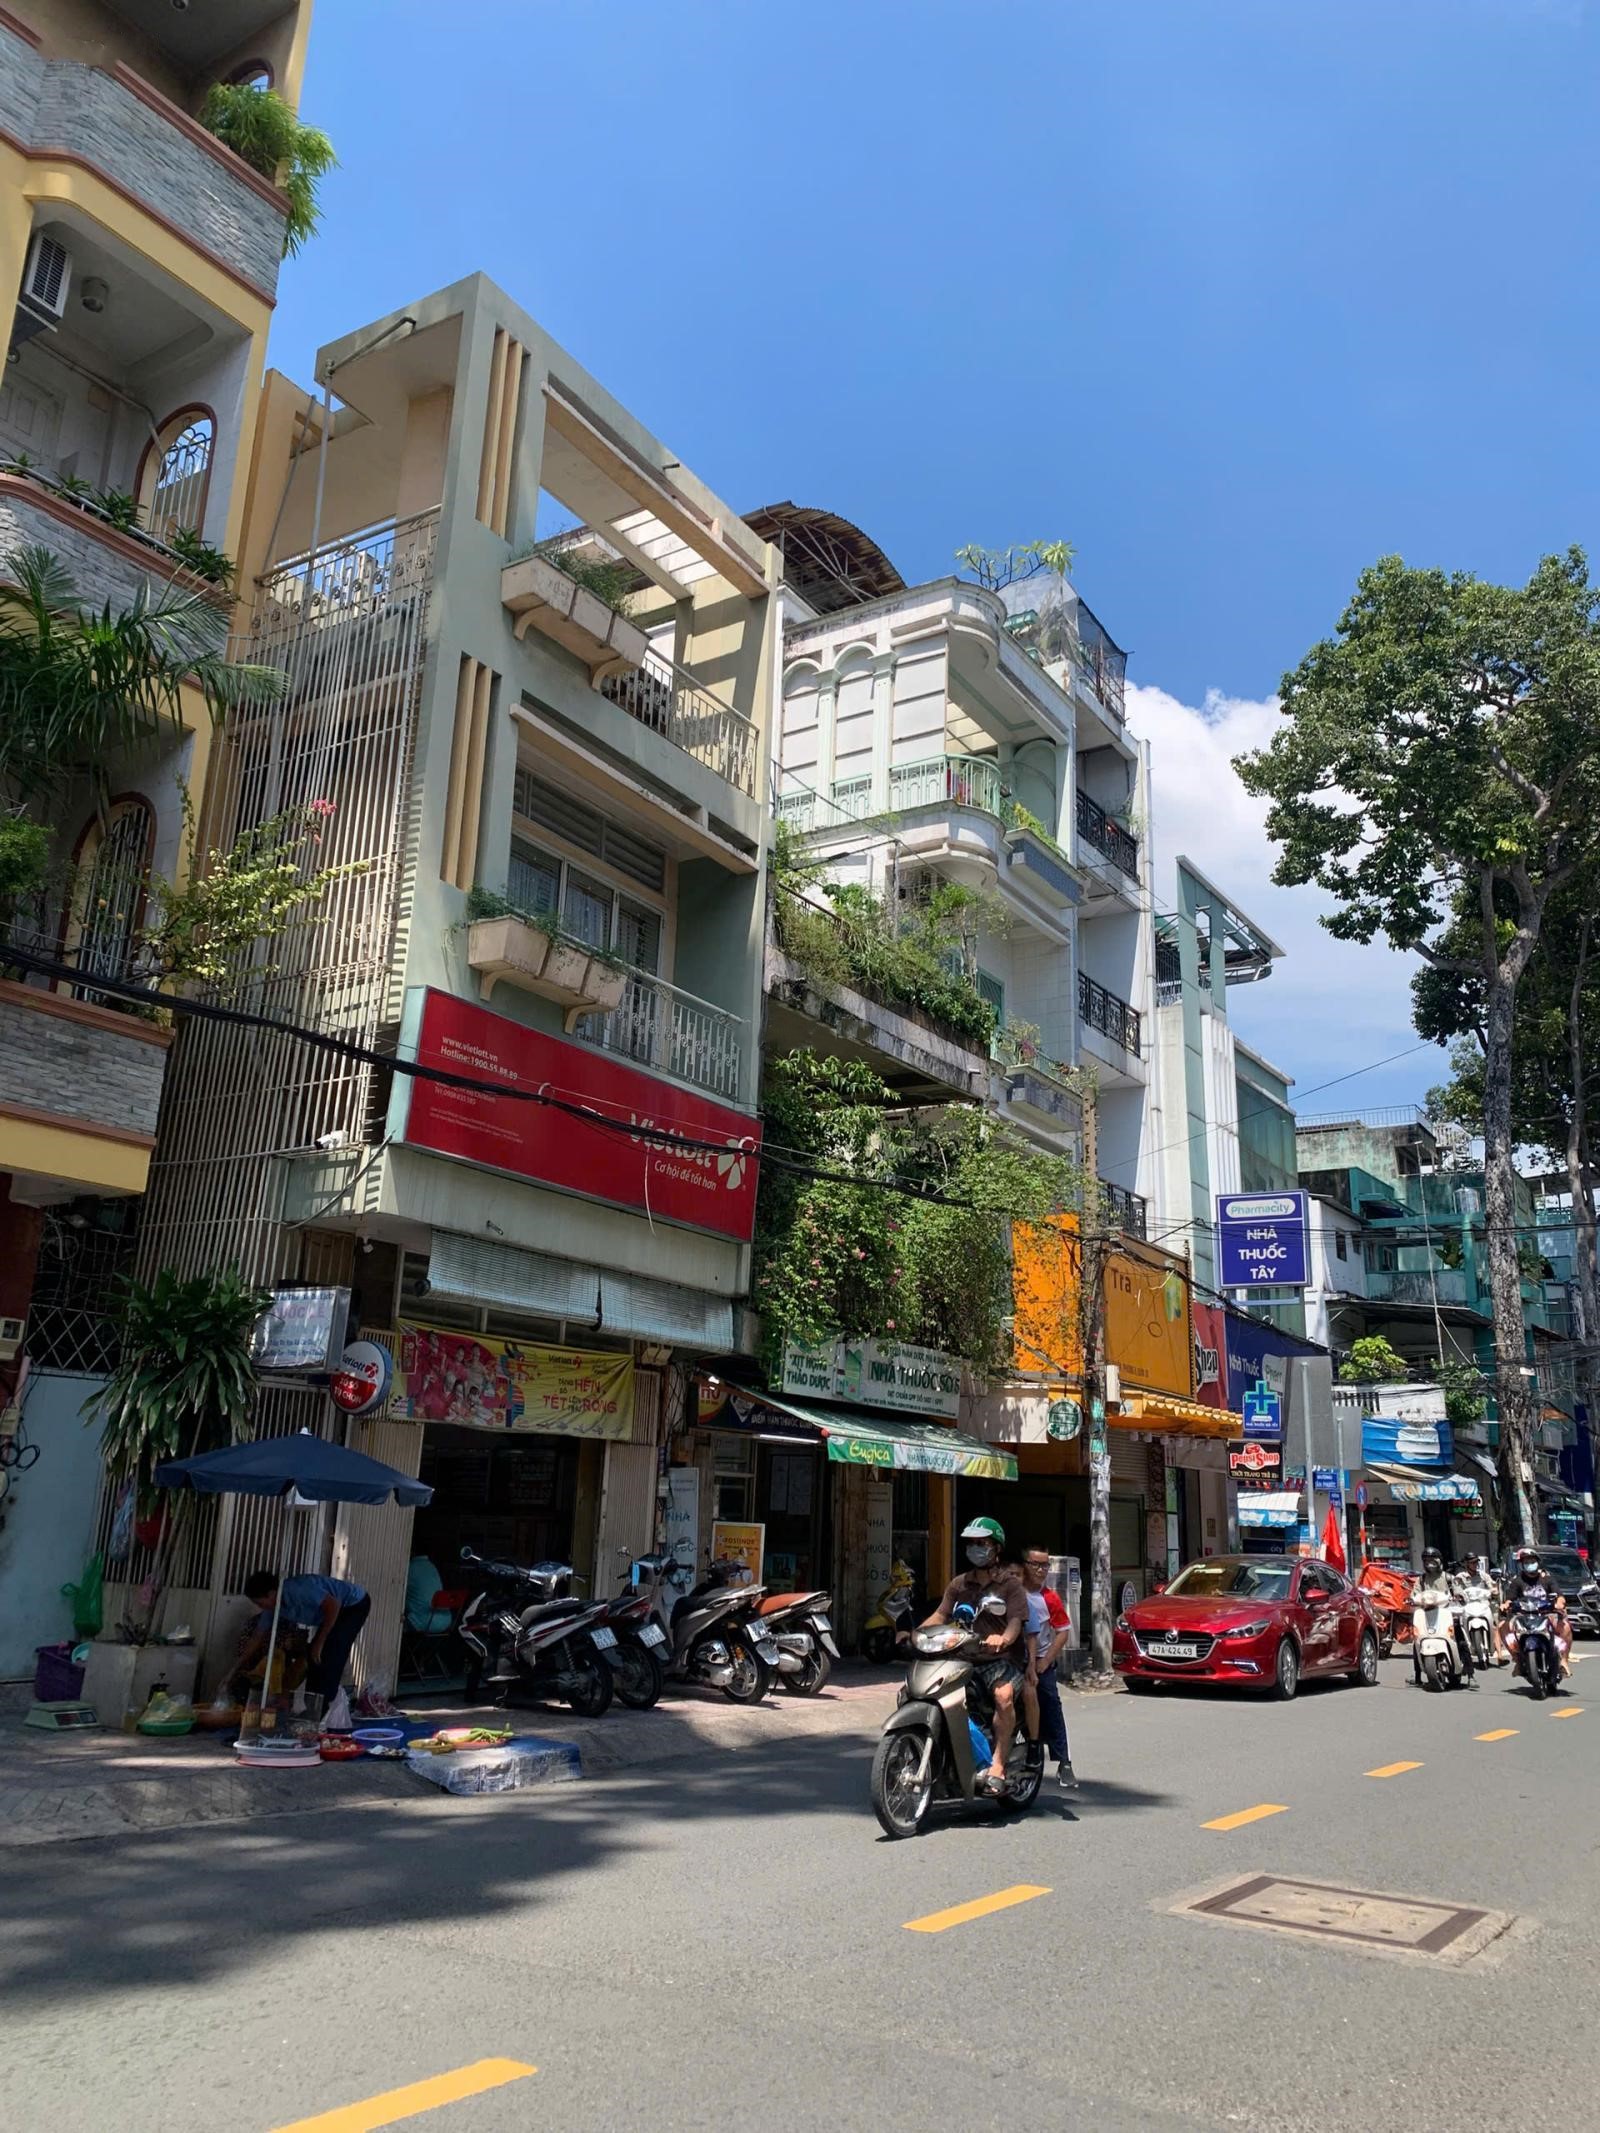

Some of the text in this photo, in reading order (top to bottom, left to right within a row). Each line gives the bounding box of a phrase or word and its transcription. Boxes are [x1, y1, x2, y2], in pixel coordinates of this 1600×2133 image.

[442, 1037, 498, 1062] www.vietlott.vn
[702, 1176, 717, 1191] hơn
[1231, 1201, 1289, 1214] Pharmacity
[1247, 1226, 1278, 1241] NHÀ
[1238, 1243, 1287, 1260] THUỐC
[1250, 1265, 1276, 1279] TÂY
[809, 1374, 831, 1392] DƯỢC
[870, 1358, 897, 1385] NHÀ
[898, 1364, 937, 1391] THUỐC
[954, 1377, 960, 1395] 5
[850, 1440, 891, 1465] Eugica
[881, 1568, 890, 1581] 5
